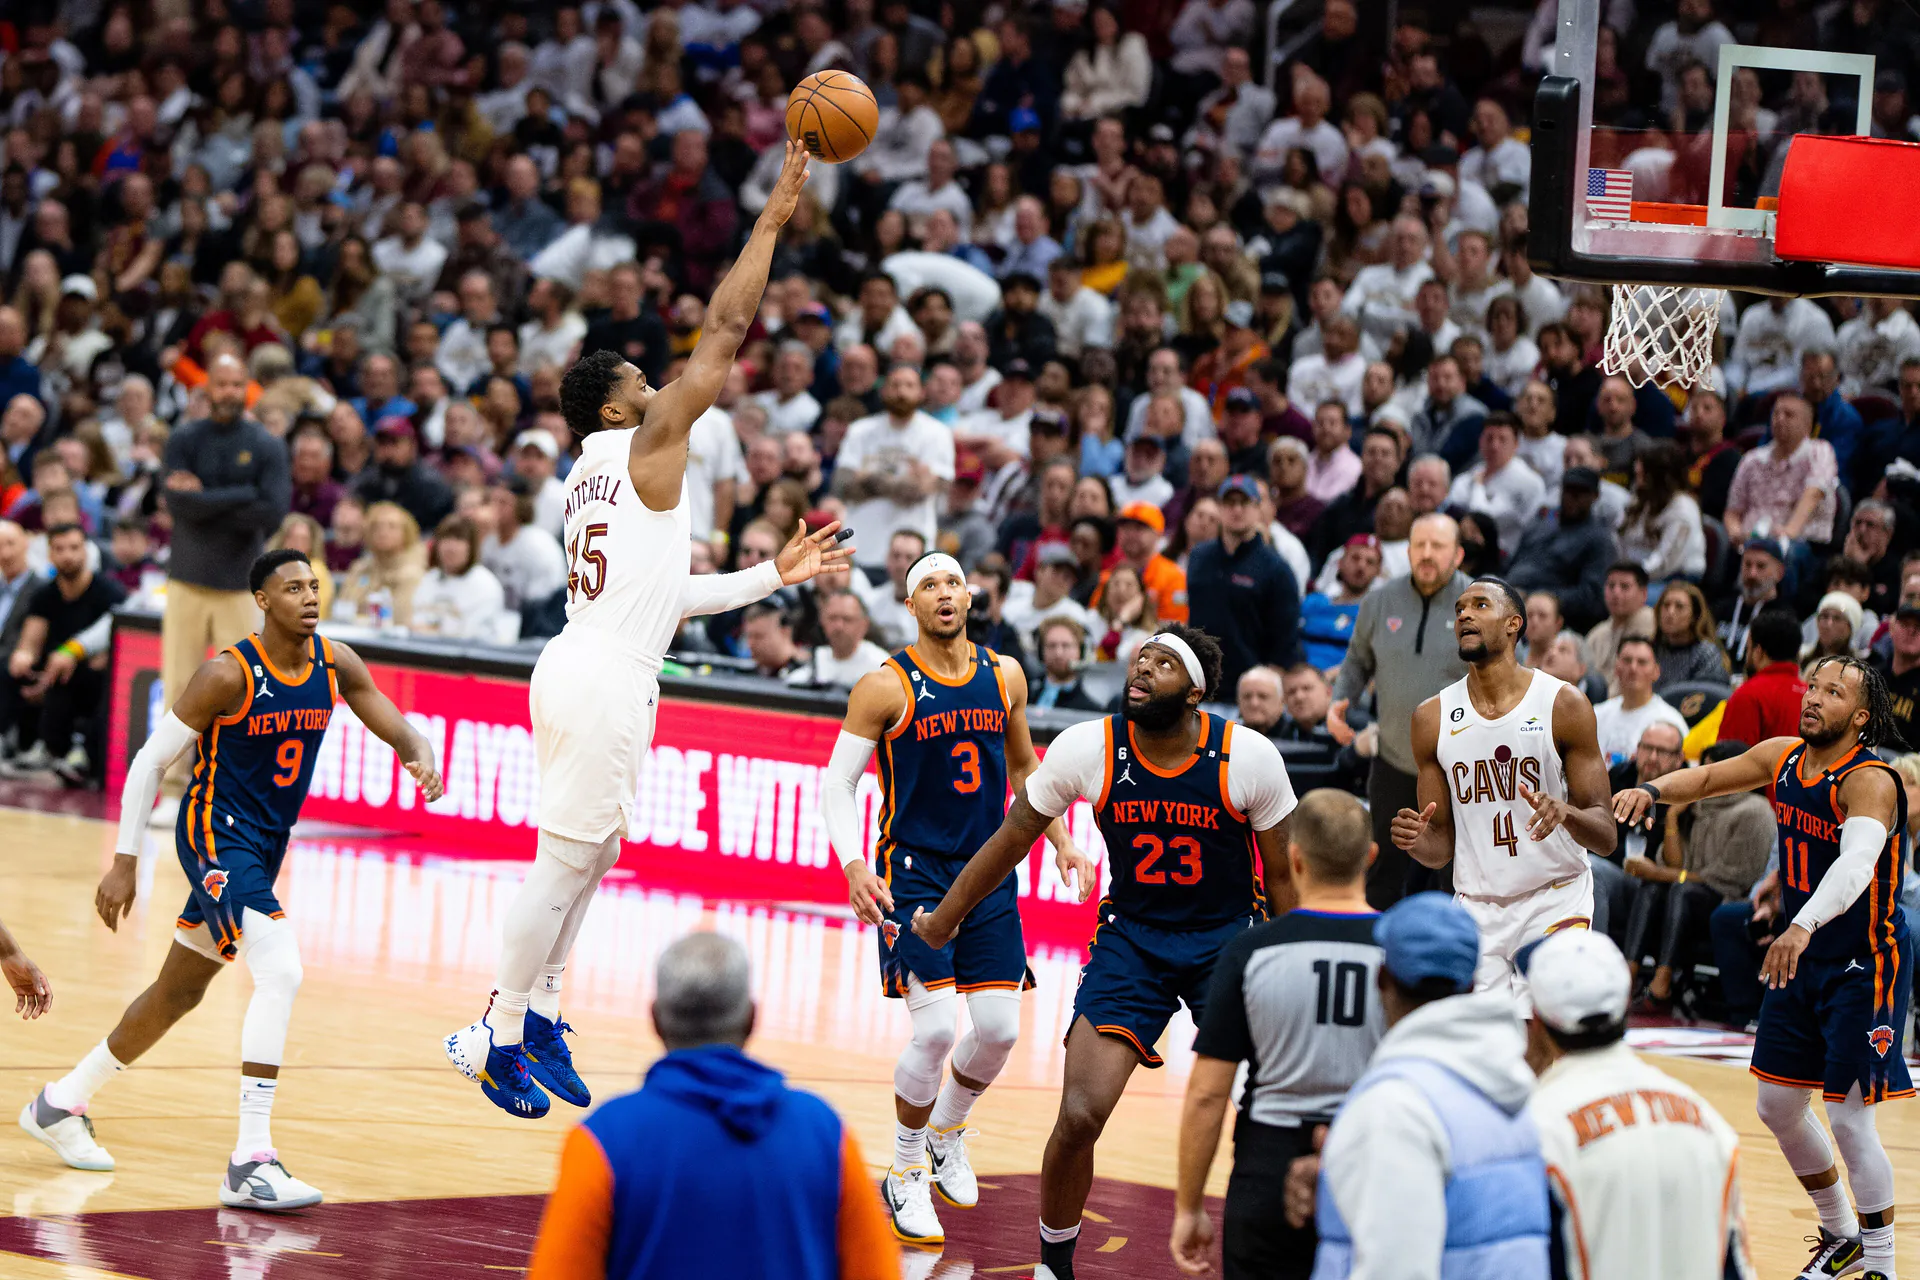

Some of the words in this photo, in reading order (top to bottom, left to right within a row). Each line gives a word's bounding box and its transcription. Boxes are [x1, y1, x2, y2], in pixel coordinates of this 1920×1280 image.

[564, 475, 621, 525] MITCHELL
[567, 522, 608, 604] 45
[247, 709, 292, 736] NEW
[293, 709, 332, 731] YORK
[915, 710, 957, 741] NEW
[959, 708, 1005, 733] YORK
[272, 739, 304, 788] 9
[951, 741, 982, 794] 3
[1118, 747, 1128, 760] 6
[628, 744, 713, 851] ODE
[1452, 756, 1540, 805] CAVS
[1112, 800, 1160, 823] NEW
[1162, 800, 1220, 830] YORK
[1492, 809, 1519, 857] 4
[1795, 807, 1839, 843] YORK
[1131, 833, 1204, 885] 23
[1785, 836, 1811, 893] 11
[1313, 960, 1368, 1028] 10
[1567, 1091, 1637, 1147] NEW
